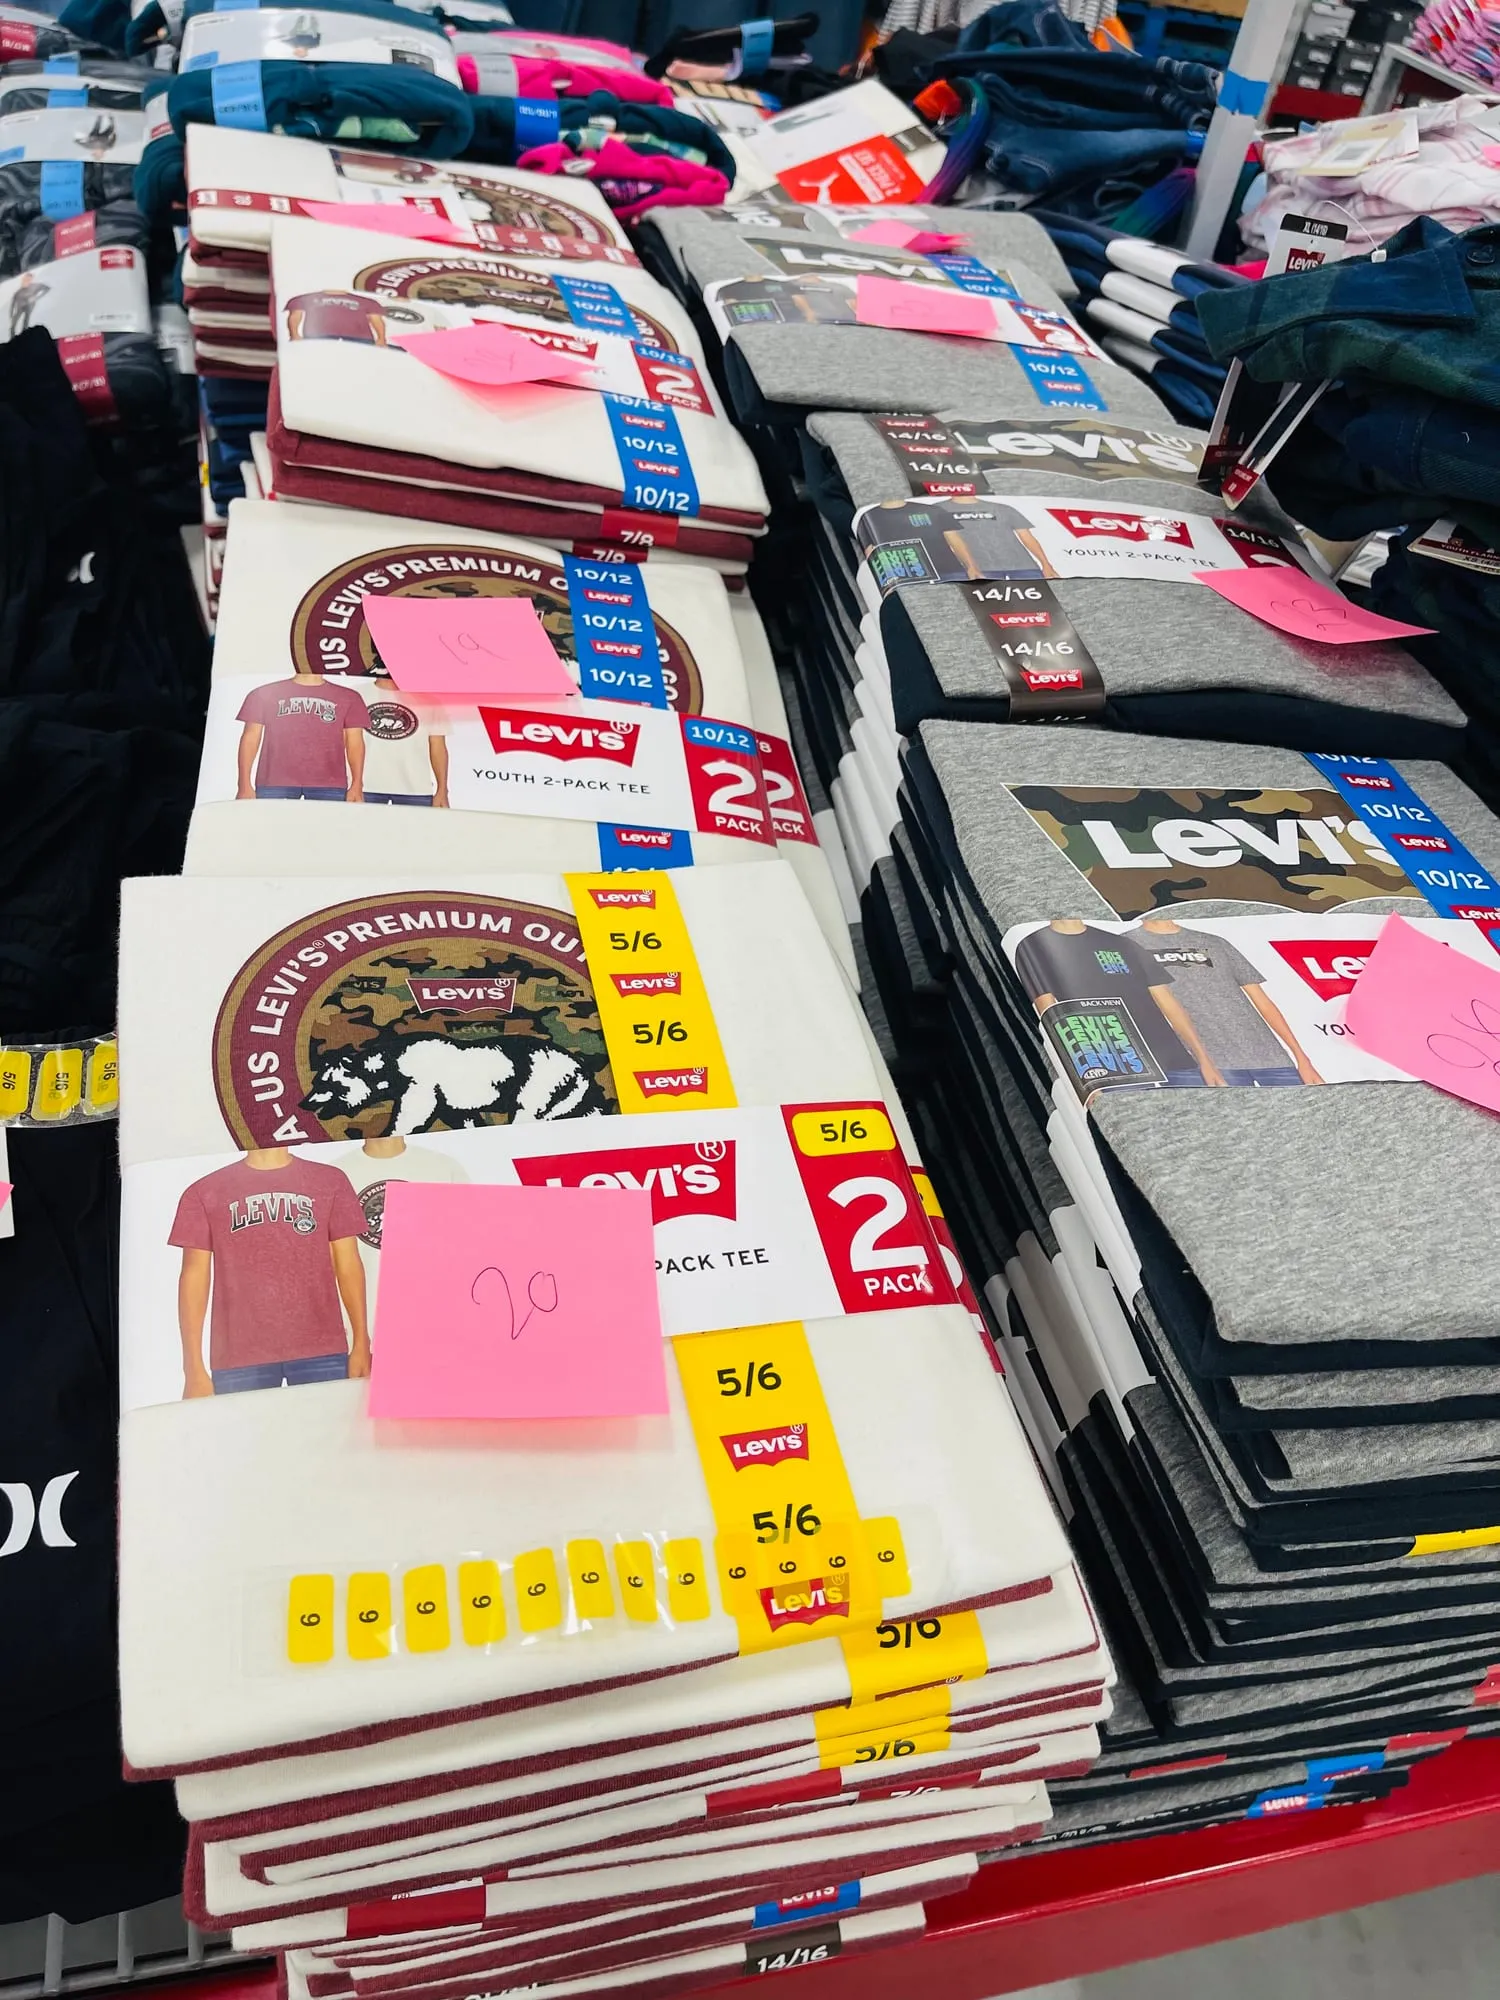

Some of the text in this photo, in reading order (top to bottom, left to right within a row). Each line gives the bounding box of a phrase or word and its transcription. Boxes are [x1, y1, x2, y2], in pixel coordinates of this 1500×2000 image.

[572, 300, 624, 315] 10/12
[639, 346, 689, 366] 10/12
[1028, 362, 1079, 376] 10/12
[649, 366, 702, 402] 2
[611, 394, 666, 412] 10/12
[662, 394, 701, 409] PACK
[622, 436, 679, 456] 10/12
[887, 432, 947, 441] 14/16
[908, 461, 971, 474] 14/16
[633, 485, 690, 511] 10/12
[620, 530, 655, 547] 7/8
[1226, 527, 1280, 549] 14/16
[1064, 549, 1219, 569] YOUTH 2-PACK TEE
[573, 567, 633, 585] 10/12
[321, 569, 390, 630] LEVI'S
[385, 555, 541, 582] PREMIUM
[971, 586, 1042, 602] 14/16
[581, 613, 644, 633] 10/12
[1001, 640, 1074, 657] 14/16
[589, 668, 653, 688] 10/12
[691, 725, 750, 749] 10/12
[473, 768, 651, 795] YOUTH 2-PACK TEE
[700, 760, 764, 822] 2
[1361, 803, 1432, 823] 10/12
[715, 816, 763, 836] PACK
[772, 821, 805, 836] ACK
[1416, 869, 1491, 890] 10/12
[608, 930, 663, 951] 5/6
[249, 946, 331, 1036] LEVI'S
[324, 909, 513, 952] PREMIUM
[632, 1020, 689, 1045] 5/6
[2, 1071, 17, 1091] 5/6
[103, 1062, 117, 1081] 5/6
[819, 1120, 868, 1142] 5/6
[229, 1192, 314, 1233] LEVI'S
[827, 1175, 930, 1273] 2
[654, 1247, 770, 1276] PACK TEE
[863, 1270, 934, 1296] PACK
[716, 1361, 782, 1398] 5/6
[752, 1503, 822, 1544] 5/6
[876, 1618, 941, 1649] 5/6
[757, 1945, 829, 1973] 14/16
